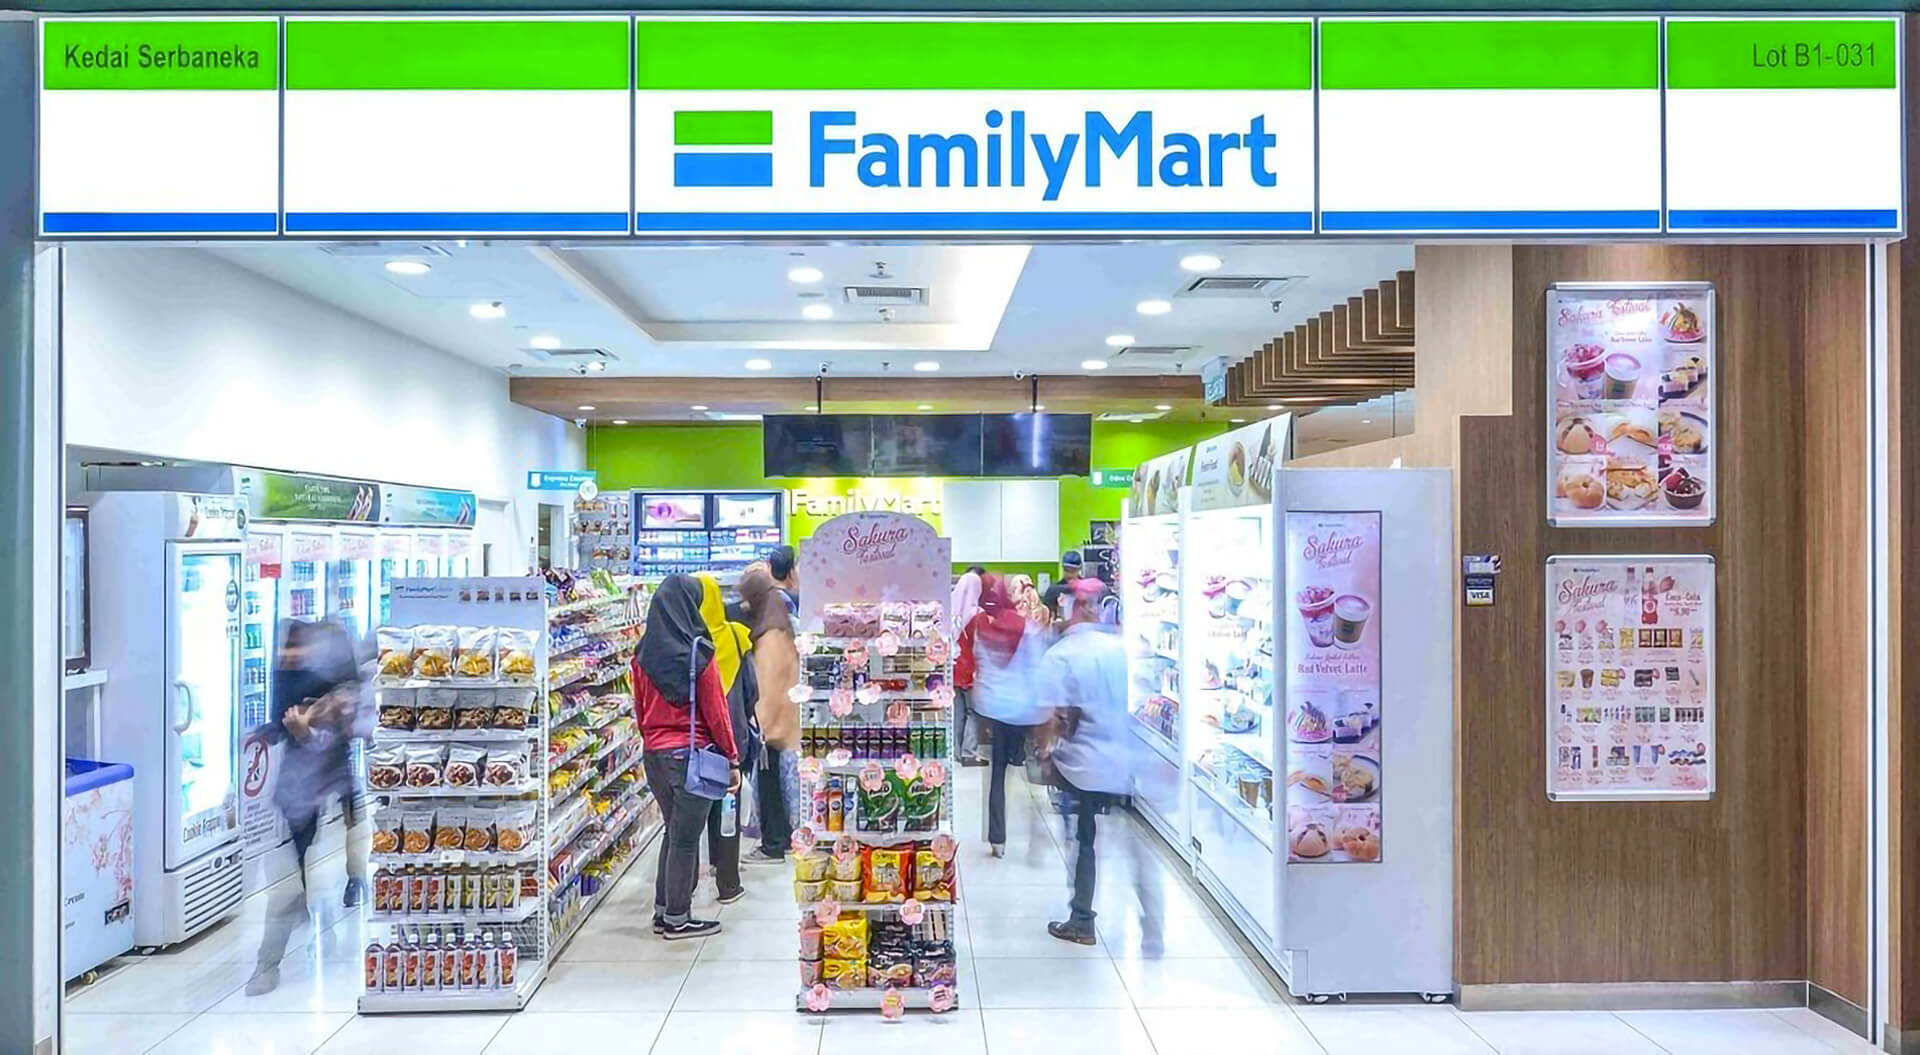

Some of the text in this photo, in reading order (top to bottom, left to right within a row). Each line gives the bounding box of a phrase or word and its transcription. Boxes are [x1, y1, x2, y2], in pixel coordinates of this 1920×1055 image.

[64, 43, 260, 69] Kedai Serbaneka
[1752, 43, 1876, 67] Lot B1-031
[809, 109, 1277, 201] FamilyMart
[842, 522, 909, 555] Sakura
[1303, 530, 1364, 560] Sakura
[1470, 591, 1490, 599] VISA
[1558, 575, 1619, 604] Sakura
[1298, 663, 1368, 674] Red Velvet Latte
